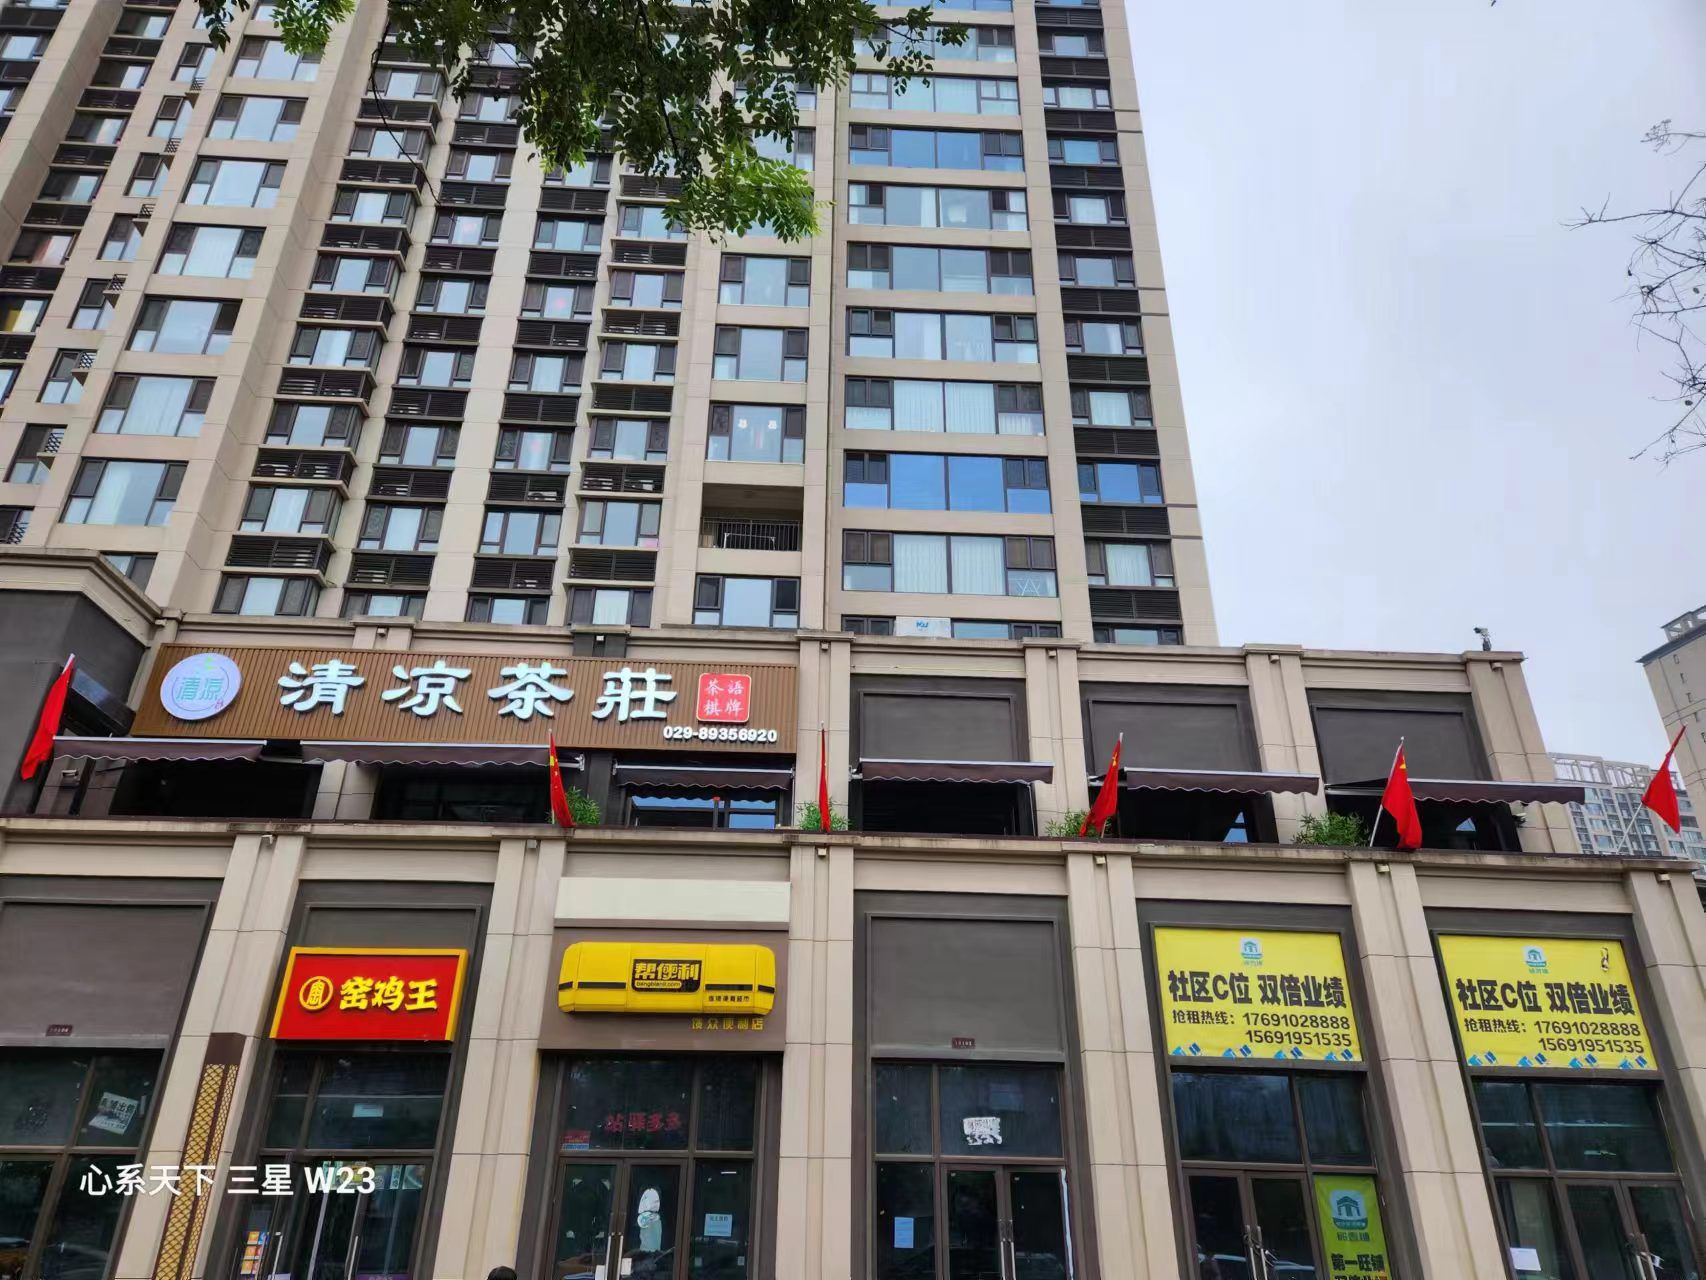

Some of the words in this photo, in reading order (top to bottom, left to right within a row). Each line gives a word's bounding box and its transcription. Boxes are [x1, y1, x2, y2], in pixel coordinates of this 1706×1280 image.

[663, 725, 778, 743] 029-89356920
[634, 962, 700, 981] 帮便利
[1168, 970, 1252, 1004] 社区C位
[1257, 974, 1347, 1008] 双倍业绩
[1456, 978, 1542, 1012] 社区C位
[1545, 982, 1636, 1015] 双倍业绩
[1242, 1013, 1350, 1029] 17691028888
[1534, 1020, 1641, 1037] 17691028888
[1246, 1030, 1352, 1046] 15691951535
[1538, 1037, 1645, 1054] 15691951535
